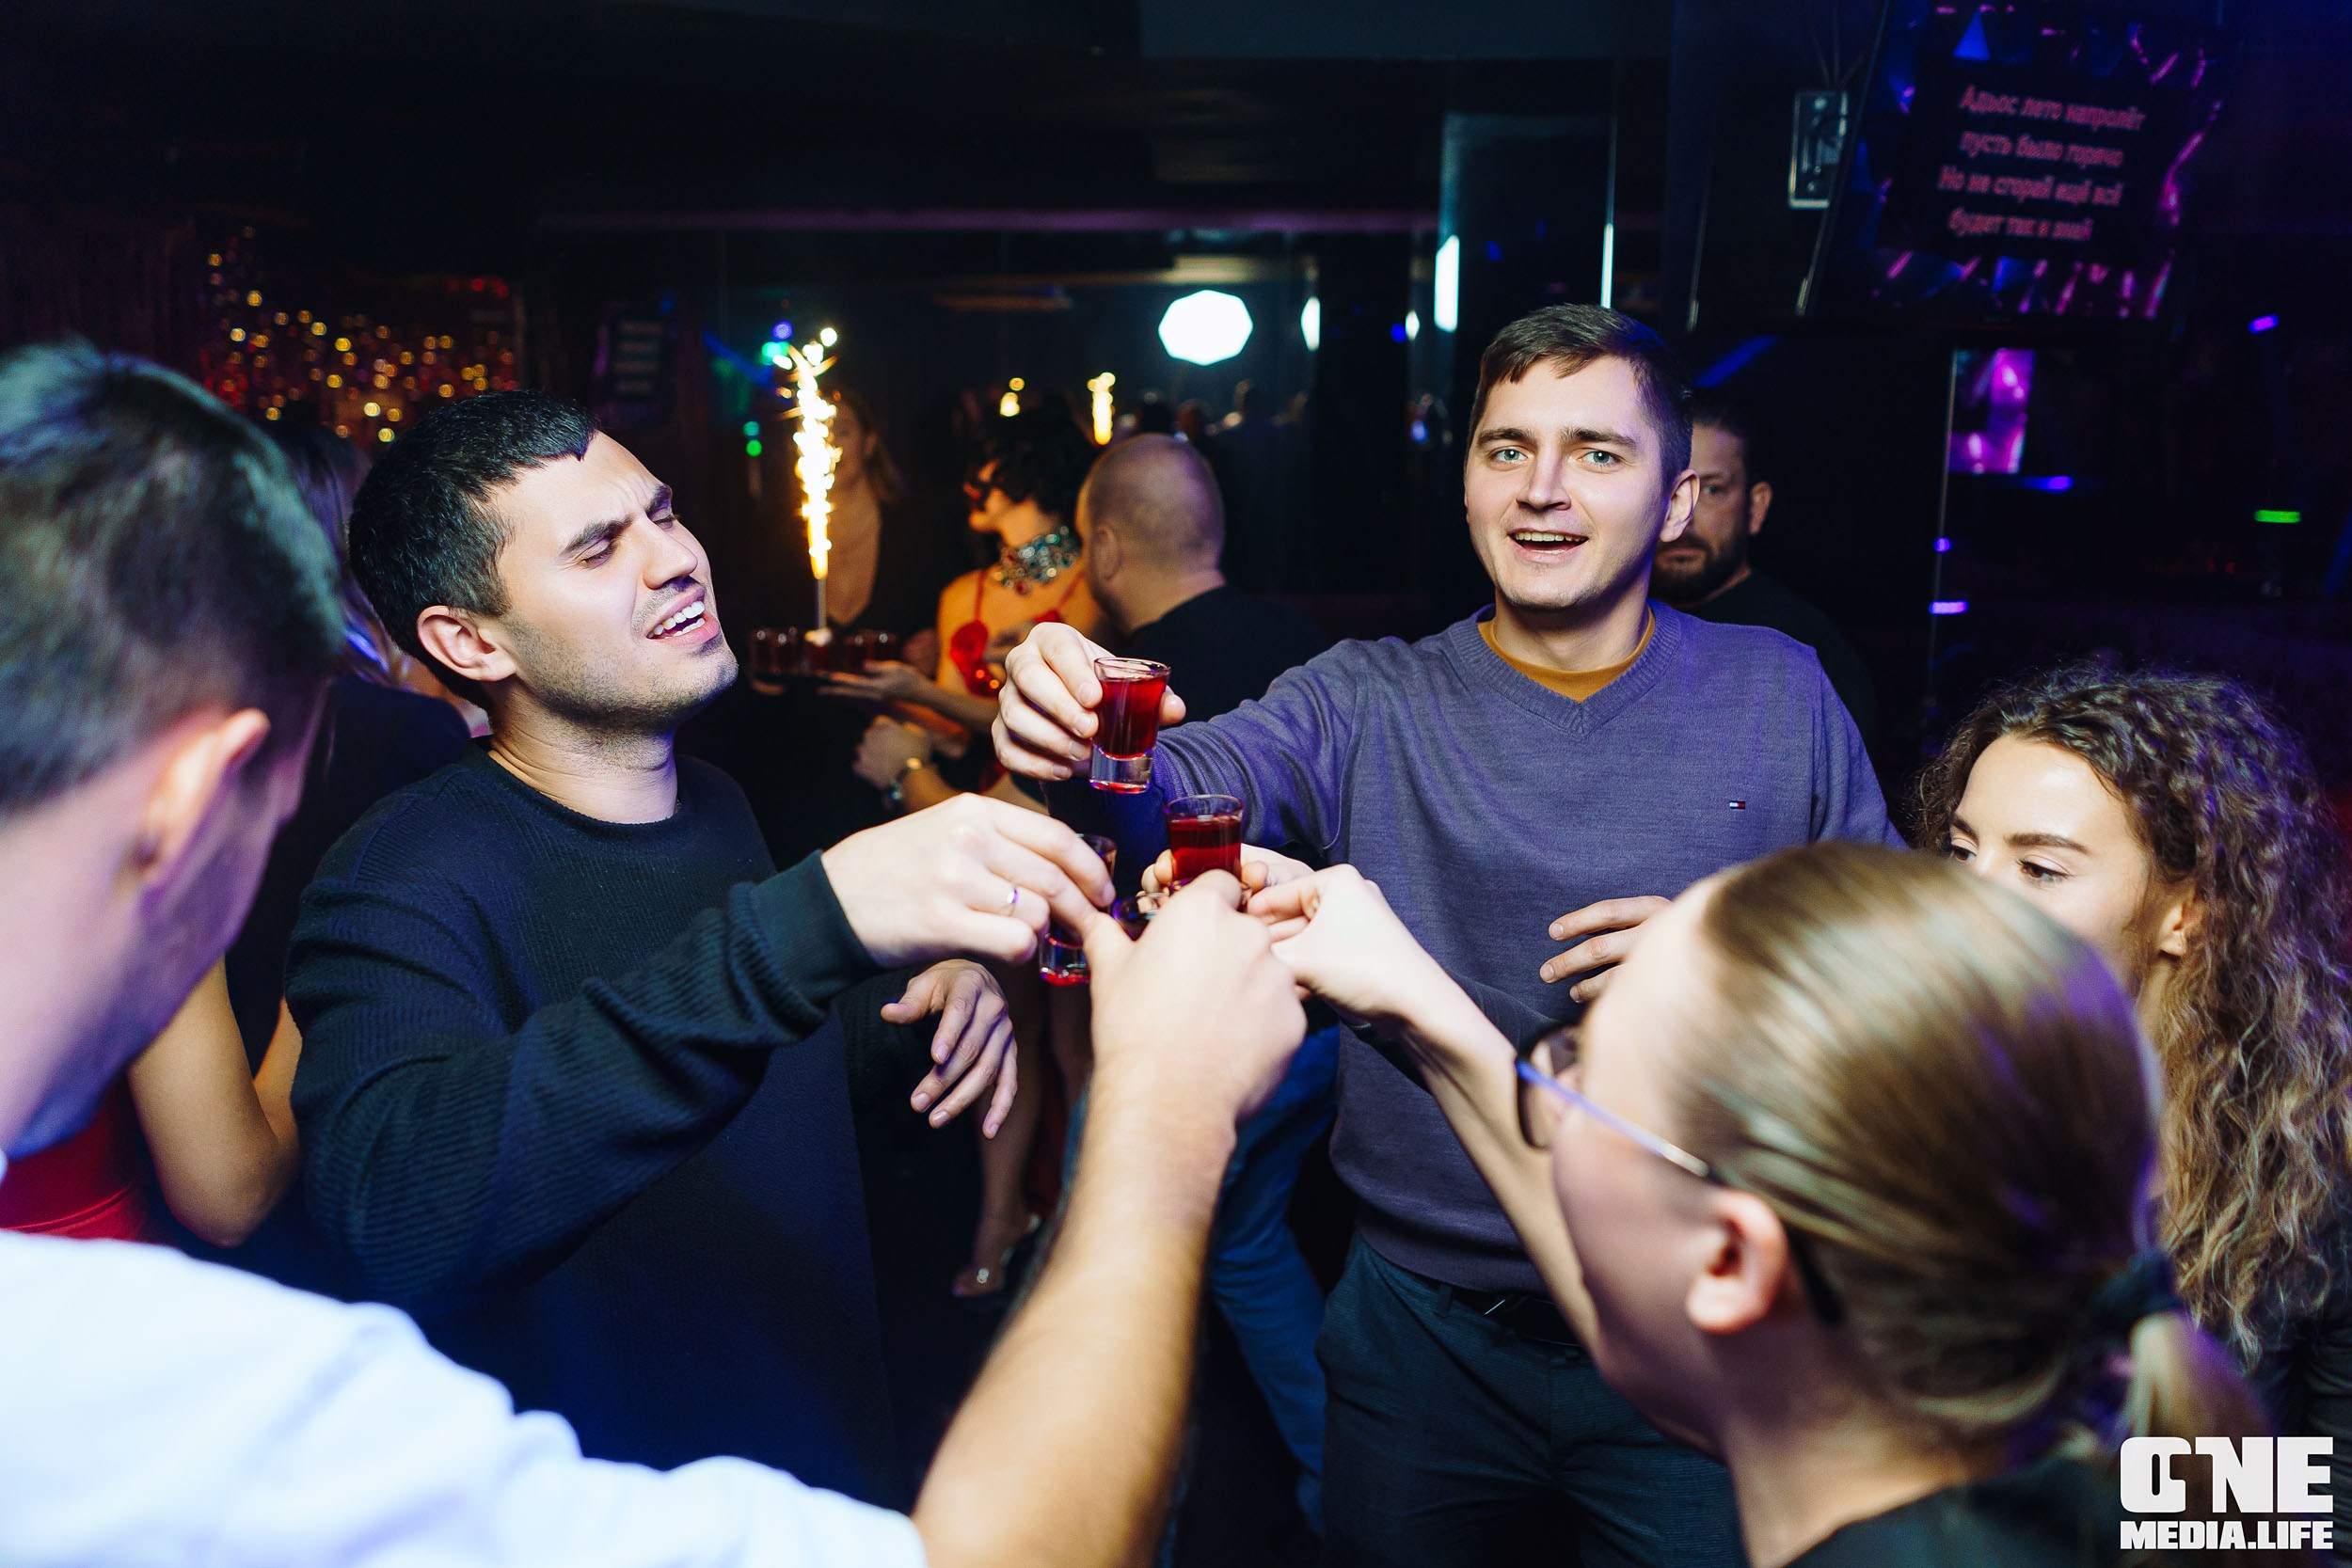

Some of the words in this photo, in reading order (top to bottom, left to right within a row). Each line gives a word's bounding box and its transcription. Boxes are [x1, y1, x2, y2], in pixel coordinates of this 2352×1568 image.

[2020, 98, 2063, 120] лето
[1961, 131, 2012, 157] пусть
[2015, 135, 2064, 160] было
[2066, 145, 2123, 167] горячо
[1939, 166, 1965, 190] Но
[1967, 175, 1992, 194] не
[1993, 177, 2054, 201] сгорай
[1948, 208, 2005, 235] будет
[2006, 217, 2037, 235] так
